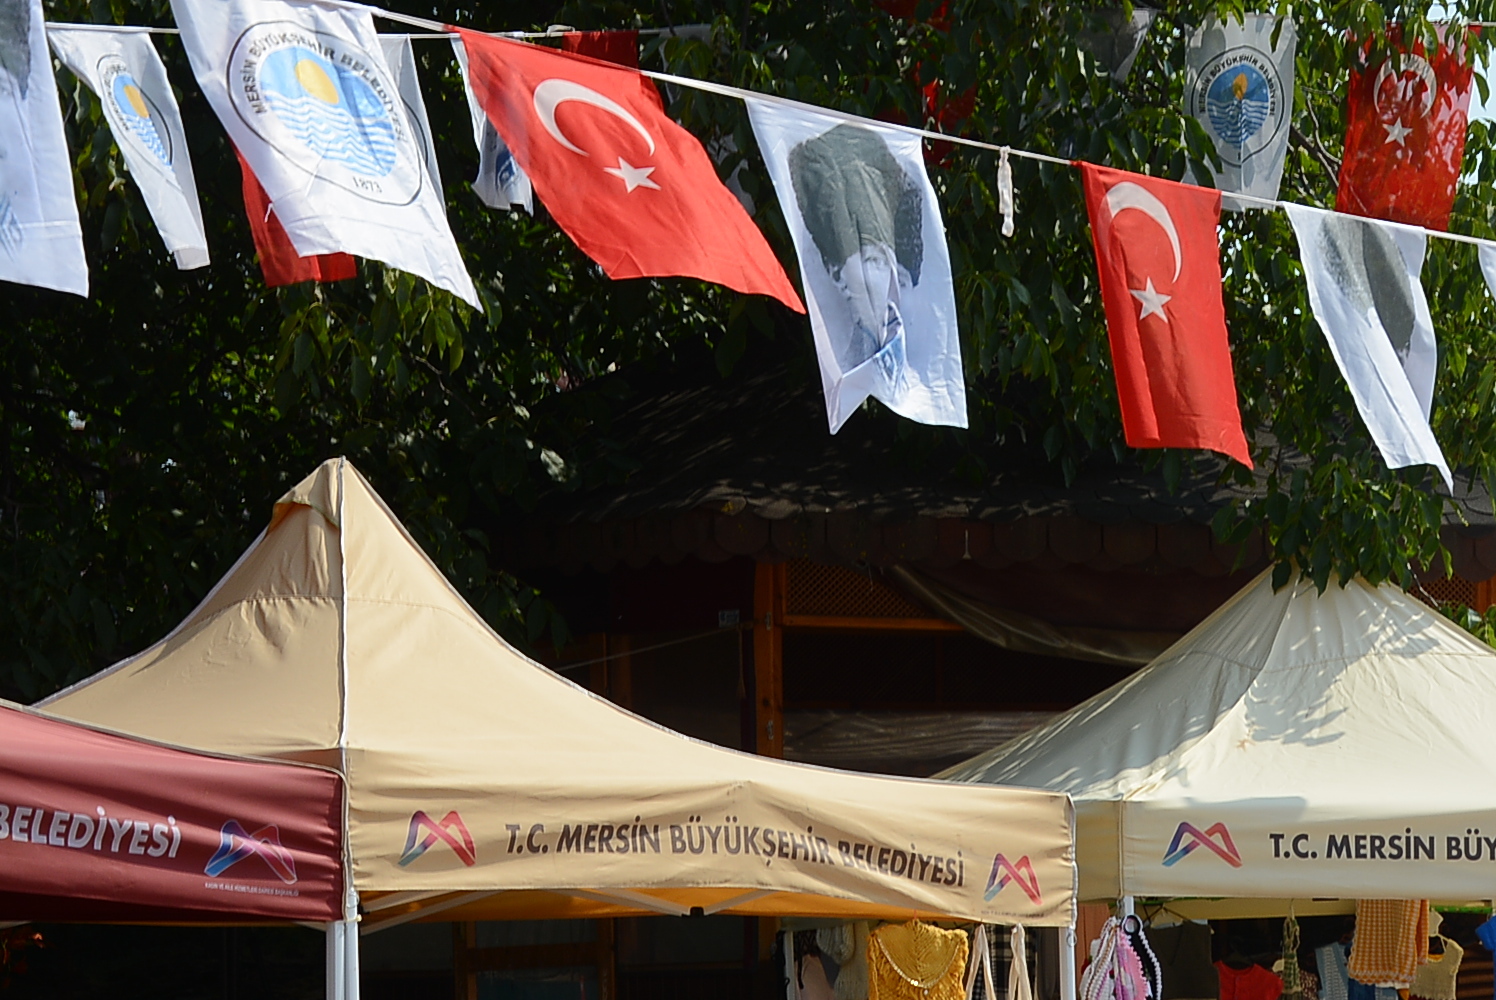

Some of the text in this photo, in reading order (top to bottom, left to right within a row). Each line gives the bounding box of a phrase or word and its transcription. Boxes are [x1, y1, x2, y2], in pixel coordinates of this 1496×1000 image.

[240, 60, 267, 115] MERSİN
[352, 176, 383, 194] 1873
[505, 814, 965, 887] T.C. MERSİN BÜYÜKŞEHİR BELEDİYESİ
[1269, 833, 1318, 859] T.C.
[1326, 827, 1435, 860] MERSİN
